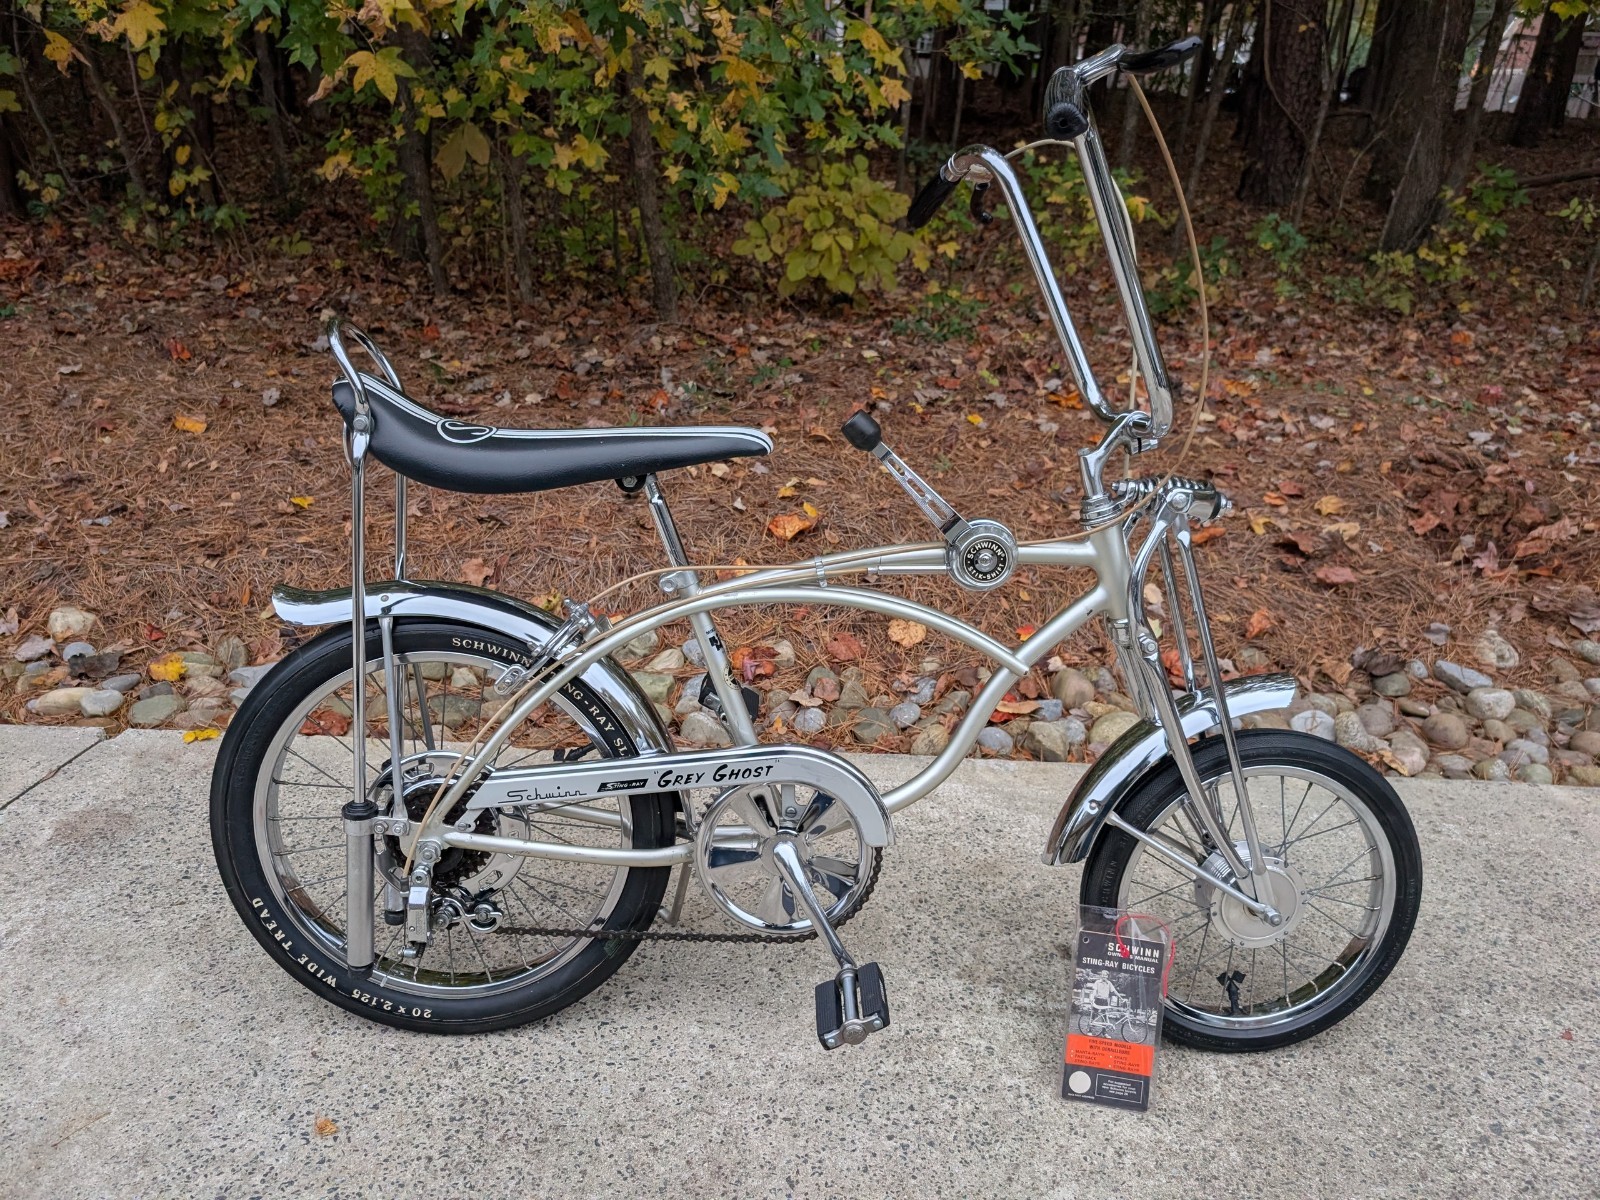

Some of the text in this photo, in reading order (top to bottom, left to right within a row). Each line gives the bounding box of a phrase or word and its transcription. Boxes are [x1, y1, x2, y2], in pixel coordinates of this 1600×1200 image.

[967, 541, 1003, 560] SCHWINN
[967, 563, 1005, 580] STIK-SHIFT
[452, 637, 532, 668] SCHWINN
[613, 737, 633, 757] SL
[603, 781, 645, 790] STING-RAY
[498, 786, 588, 804] Schwinn
[252, 897, 293, 951] TREAD
[1082, 957, 1155, 974] STING-RAY BICYCLES
[1107, 951, 1159, 963] OWNS MANUAL
[297, 953, 338, 988] WIDE
[351, 988, 394, 1011] 2.125
[411, 1009, 432, 1019] 20
